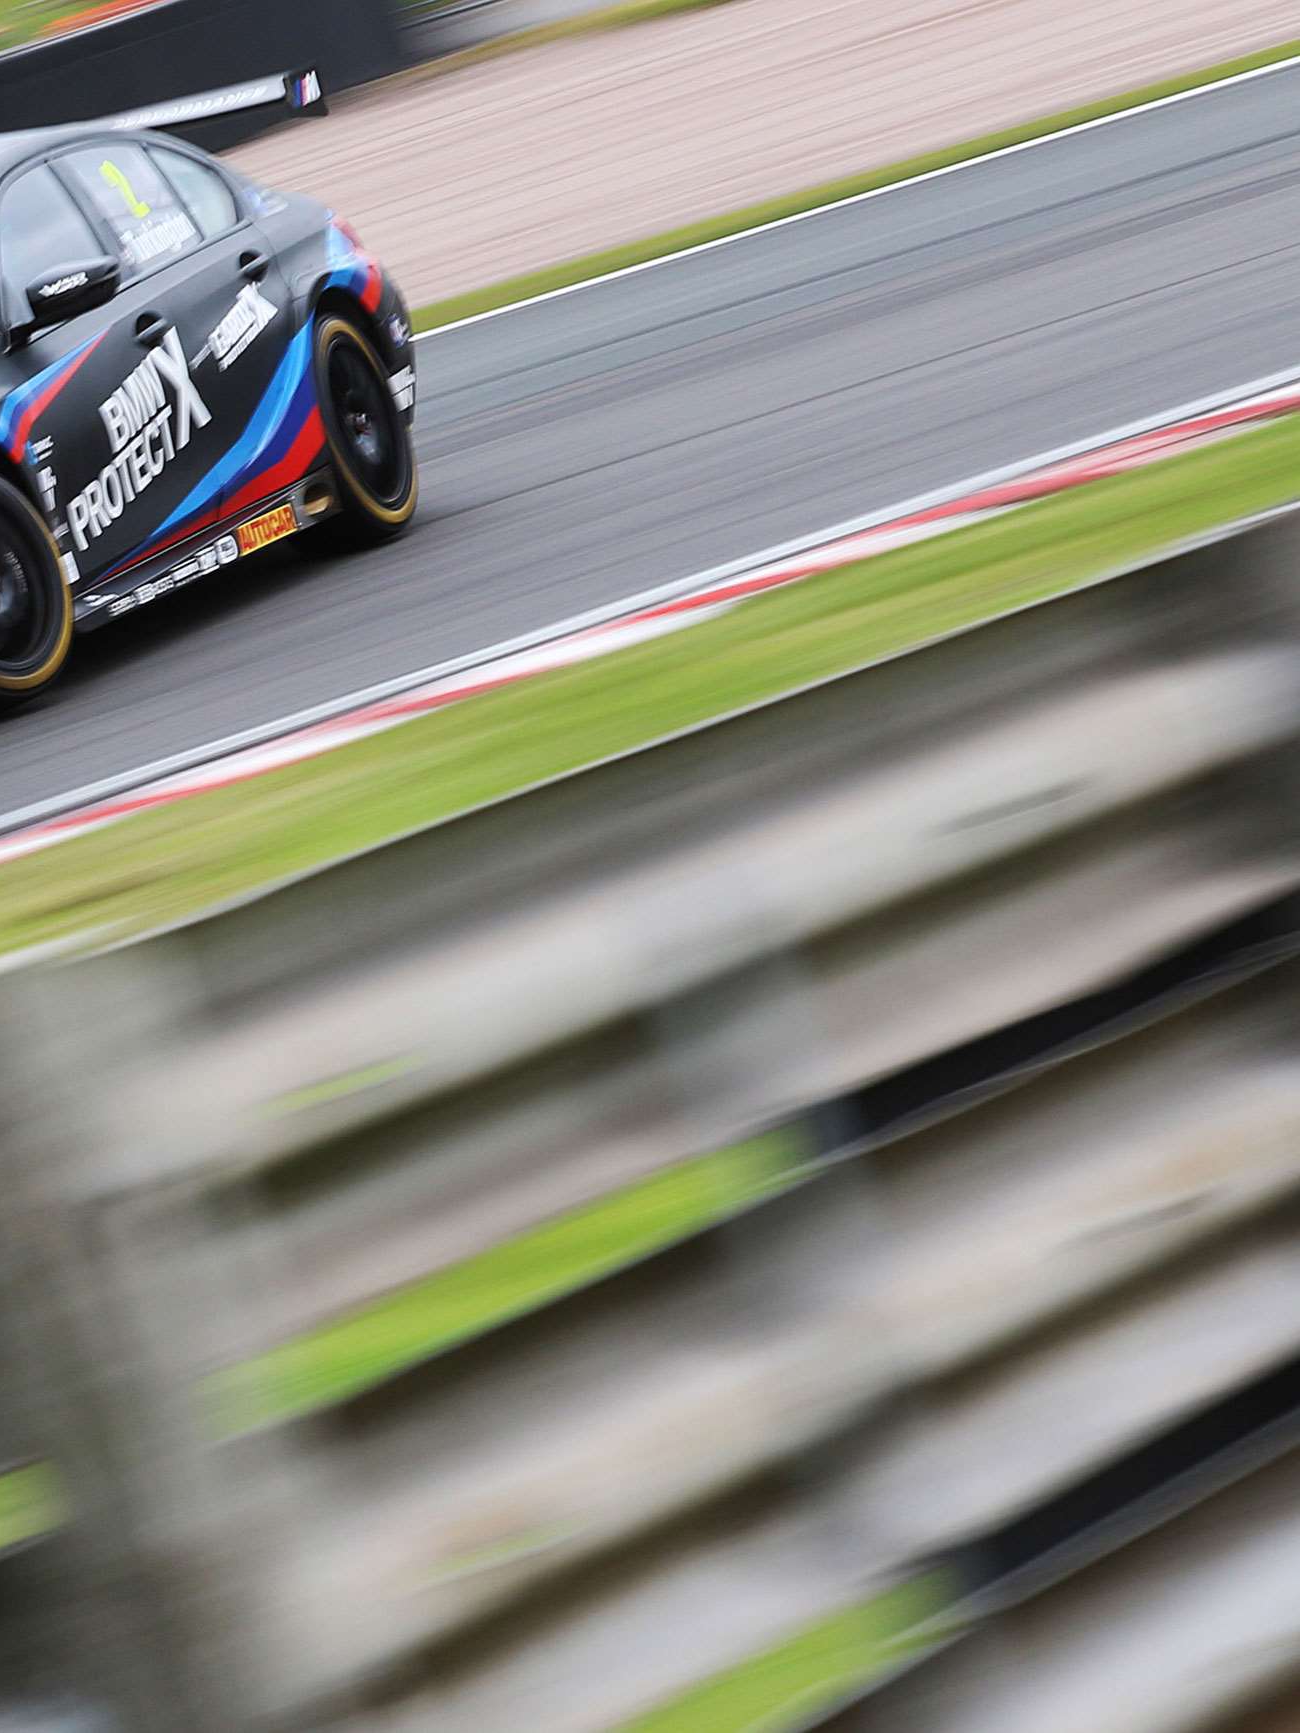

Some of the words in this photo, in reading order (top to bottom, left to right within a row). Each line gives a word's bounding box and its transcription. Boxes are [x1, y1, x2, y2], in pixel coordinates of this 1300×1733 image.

[99, 352, 166, 454] BMW
[151, 326, 212, 450] X
[66, 404, 175, 551] PROTECT
[236, 505, 297, 552] AUTOCAR
